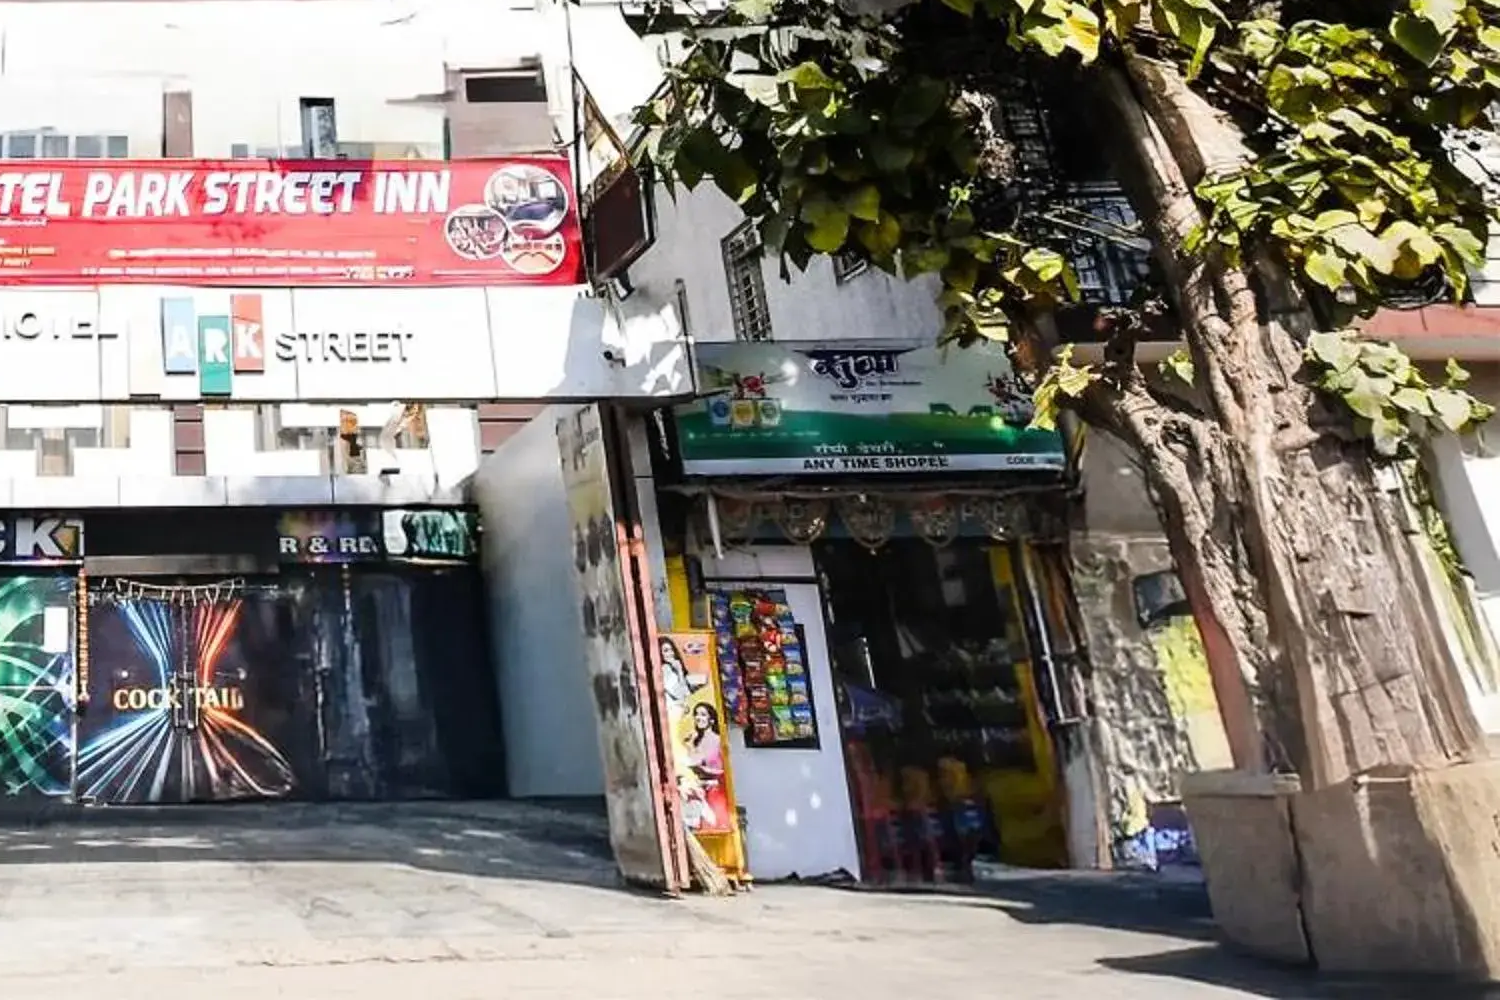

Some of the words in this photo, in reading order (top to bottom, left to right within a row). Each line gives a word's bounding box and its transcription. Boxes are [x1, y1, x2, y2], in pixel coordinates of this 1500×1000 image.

[82, 171, 194, 217] PARK
[203, 171, 362, 215] STREET
[373, 170, 450, 213] INN
[275, 331, 414, 363] STREET
[803, 459, 835, 469] ANY
[841, 457, 880, 468] TIME
[113, 688, 181, 710] COCK
